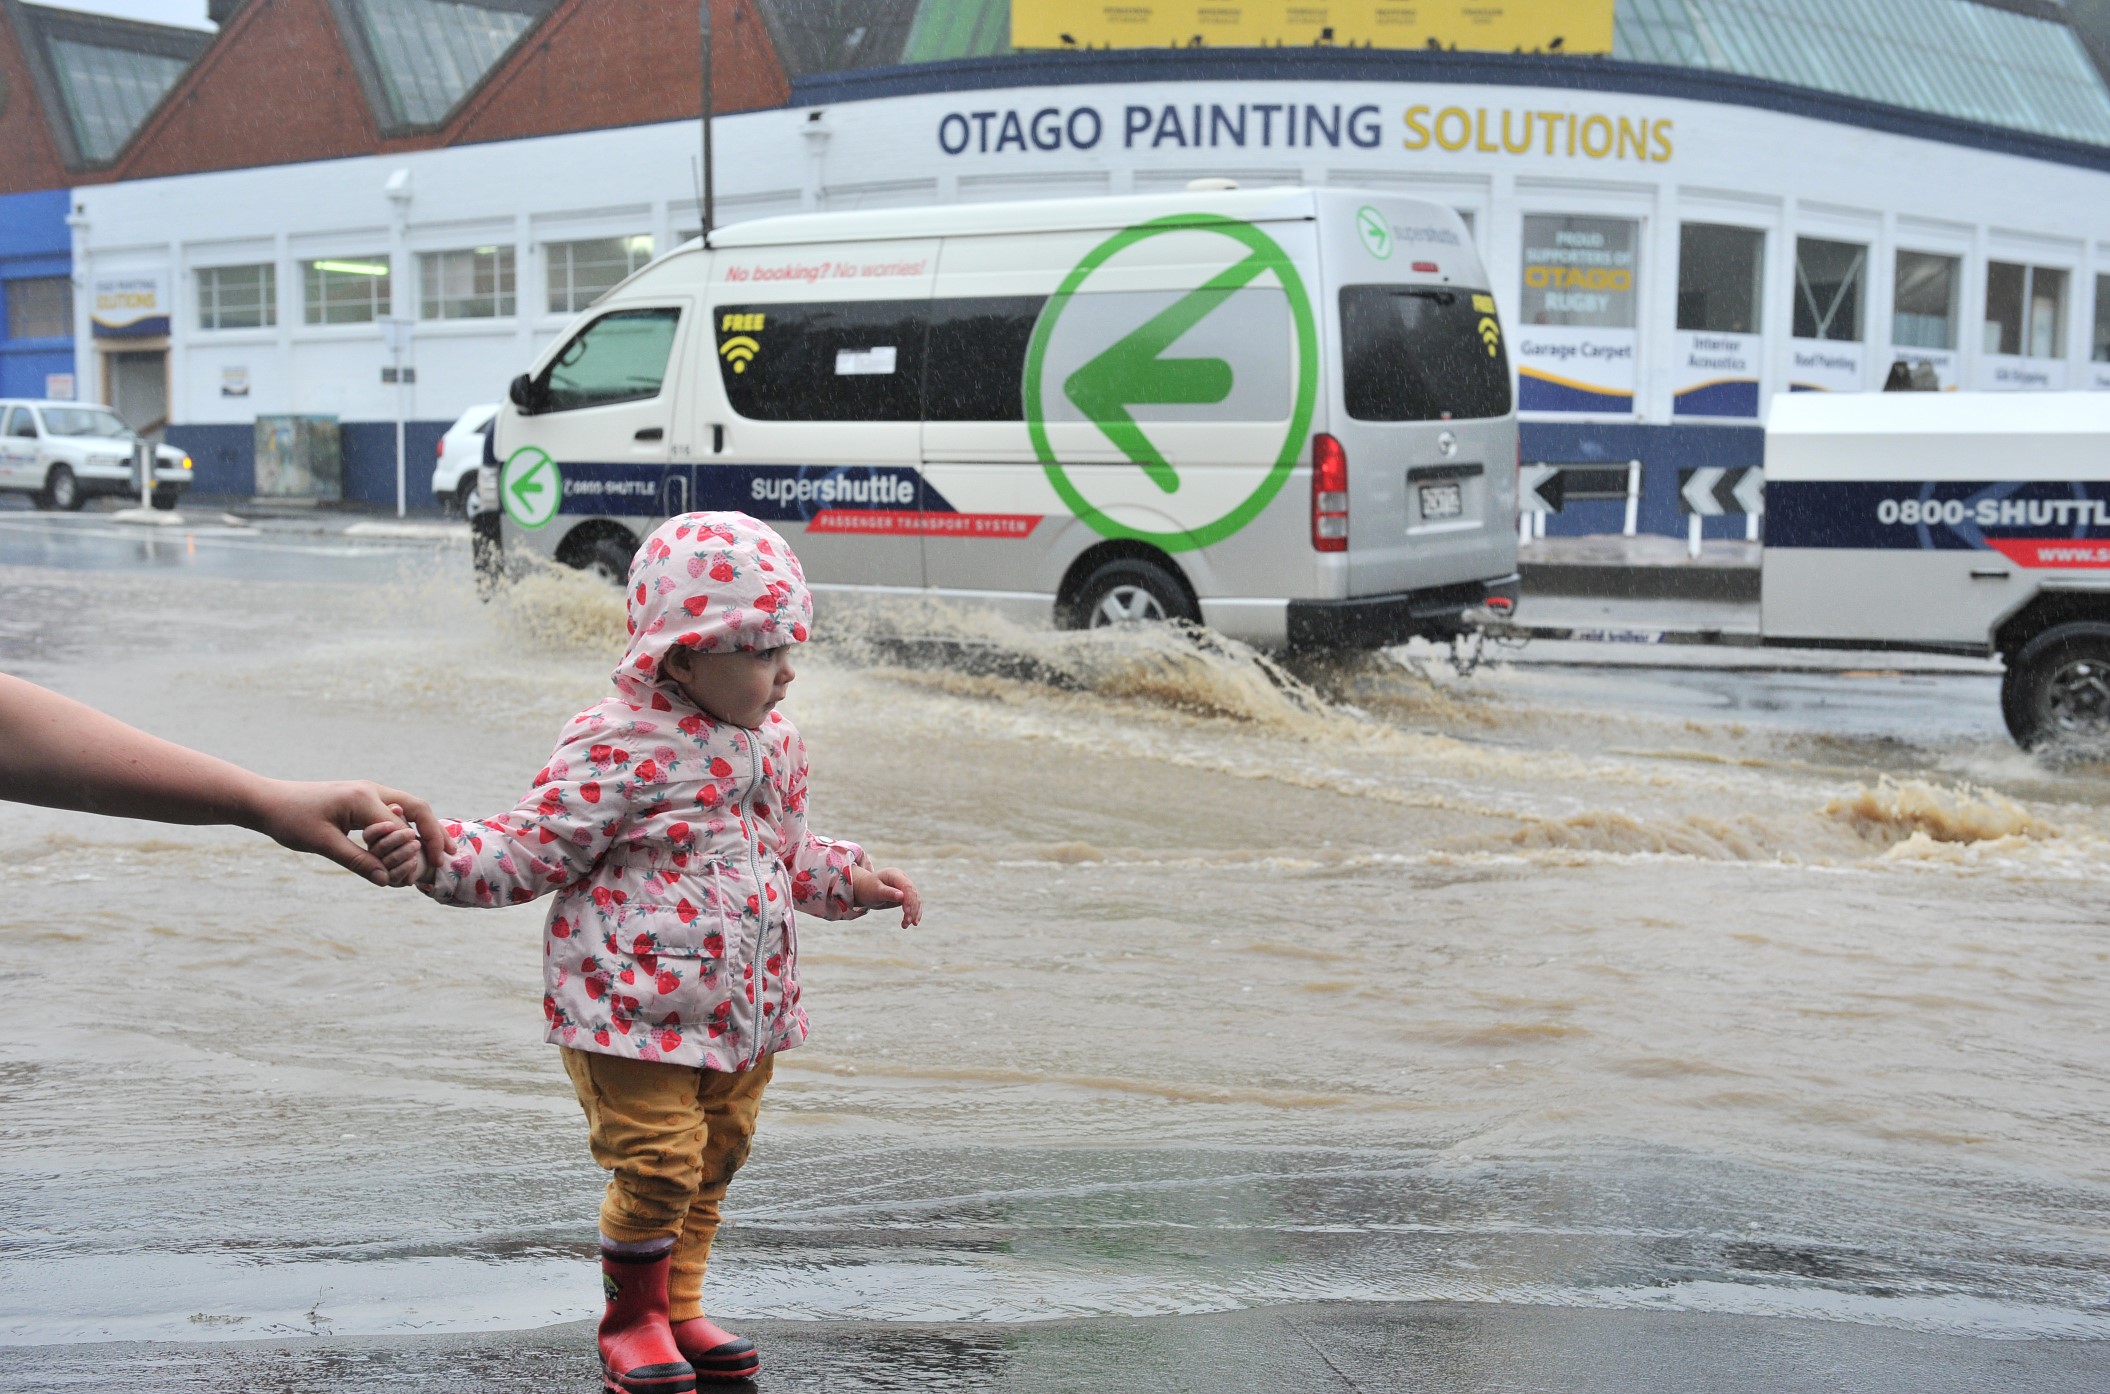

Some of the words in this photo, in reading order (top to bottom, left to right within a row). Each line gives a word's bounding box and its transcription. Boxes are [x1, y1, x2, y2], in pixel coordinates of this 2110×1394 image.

[938, 106, 1103, 156] OTAGO
[1123, 104, 1383, 150] PAINTING
[1402, 104, 1675, 163] SOLUTIONS
[725, 264, 749, 283] No
[751, 261, 833, 285] booking?
[833, 261, 856, 280] No
[1524, 265, 1633, 293] OTAGO
[1544, 291, 1610, 314] RUGBY
[721, 313, 766, 332] FREE
[1520, 340, 1577, 361] Garage
[1580, 341, 1632, 363] Carpet
[751, 474, 914, 508] supershuttle
[821, 516, 893, 528] PASSENGER
[897, 518, 970, 531] TRANSPORT
[975, 520, 1027, 532] SYSTEM
[2037, 548, 2110, 563] www.s
